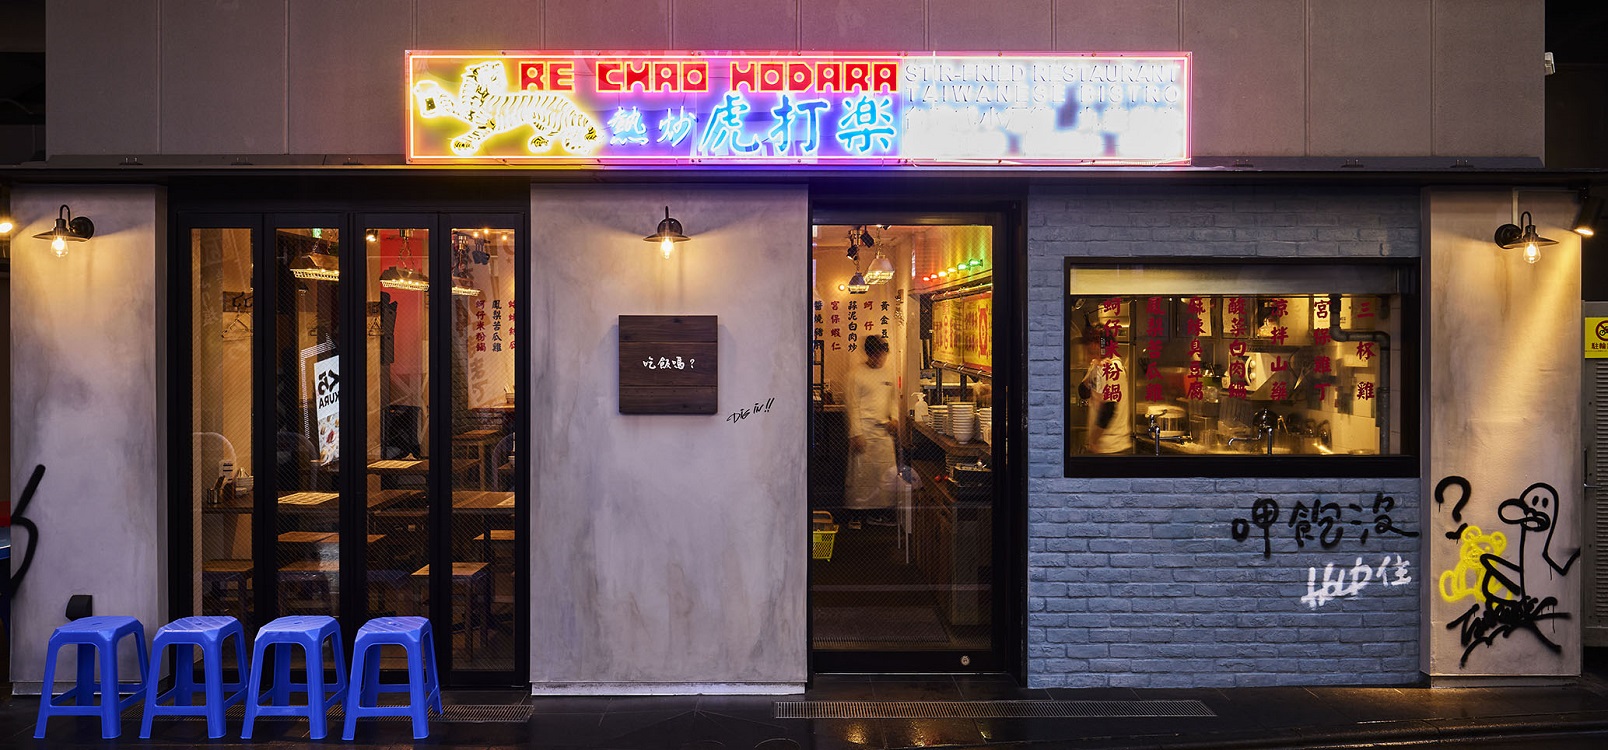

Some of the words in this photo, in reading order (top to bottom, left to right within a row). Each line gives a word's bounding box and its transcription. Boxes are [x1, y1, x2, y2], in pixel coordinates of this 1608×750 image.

[519, 61, 575, 92] RE
[596, 61, 708, 92] CHAO
[730, 61, 898, 92] HODARA
[1032, 63, 1179, 83] RESTAURANT
[1591, 342, 1608, 350] 駐輪
